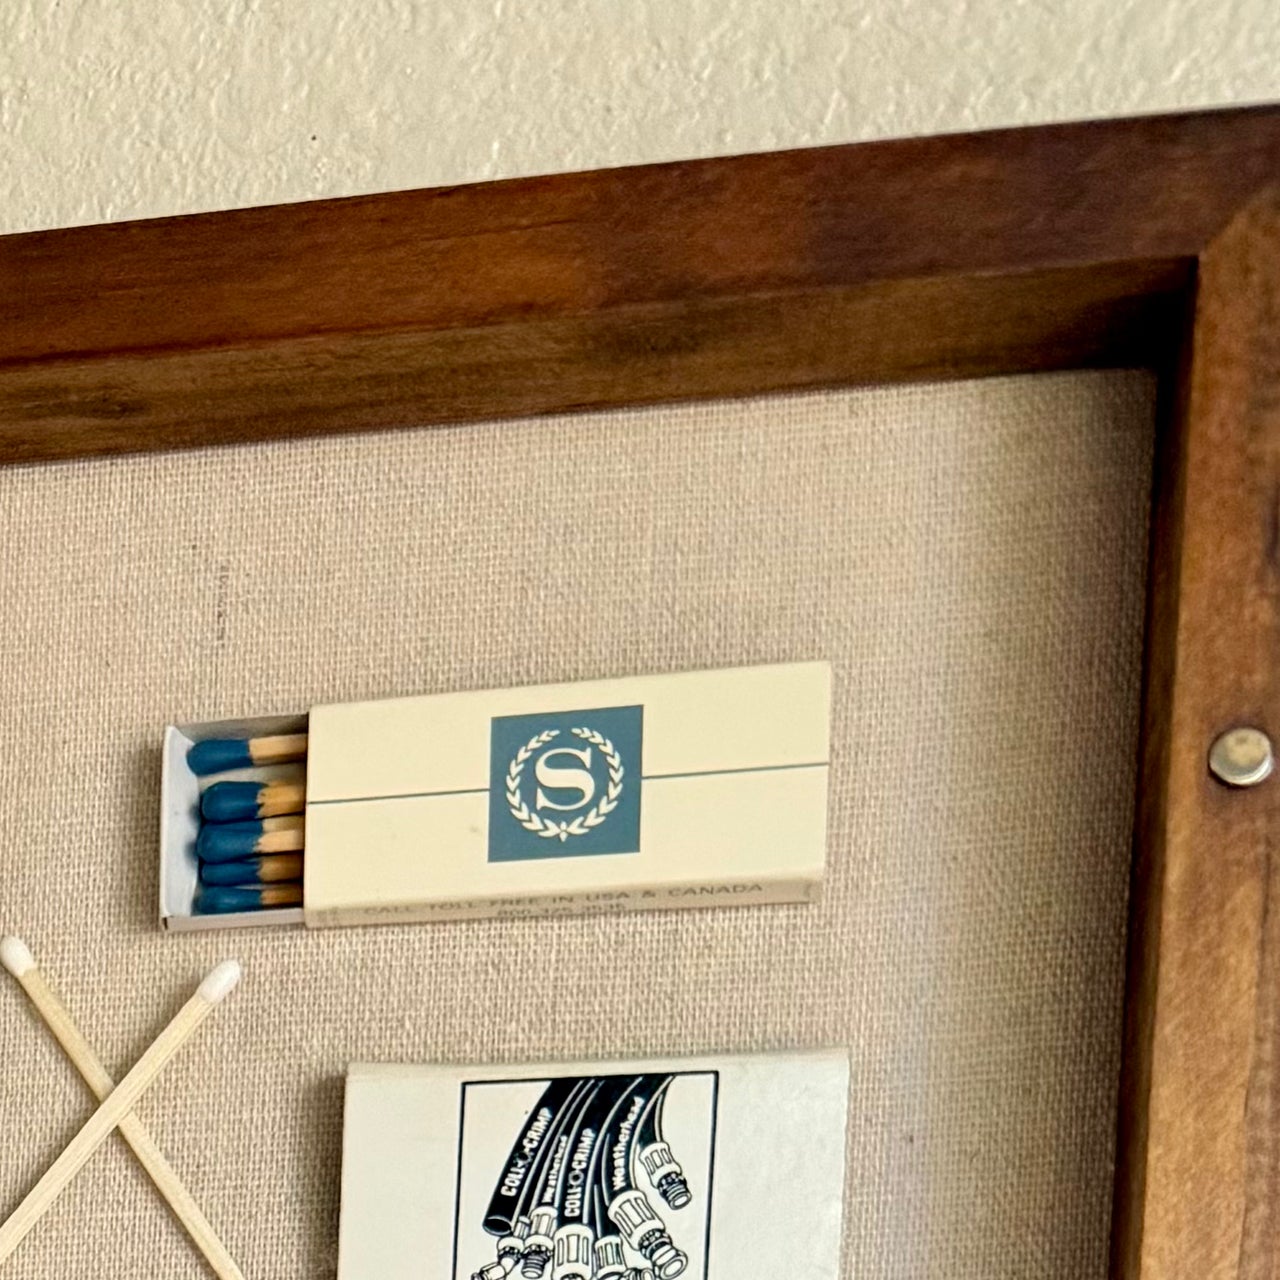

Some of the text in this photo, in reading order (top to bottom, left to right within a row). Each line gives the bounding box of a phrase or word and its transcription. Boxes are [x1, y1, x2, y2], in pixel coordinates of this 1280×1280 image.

[535, 748, 594, 813] S
[586, 892, 630, 902] USA
[668, 884, 763, 896] CANADA
[612, 1096, 645, 1190] Weatherhead
